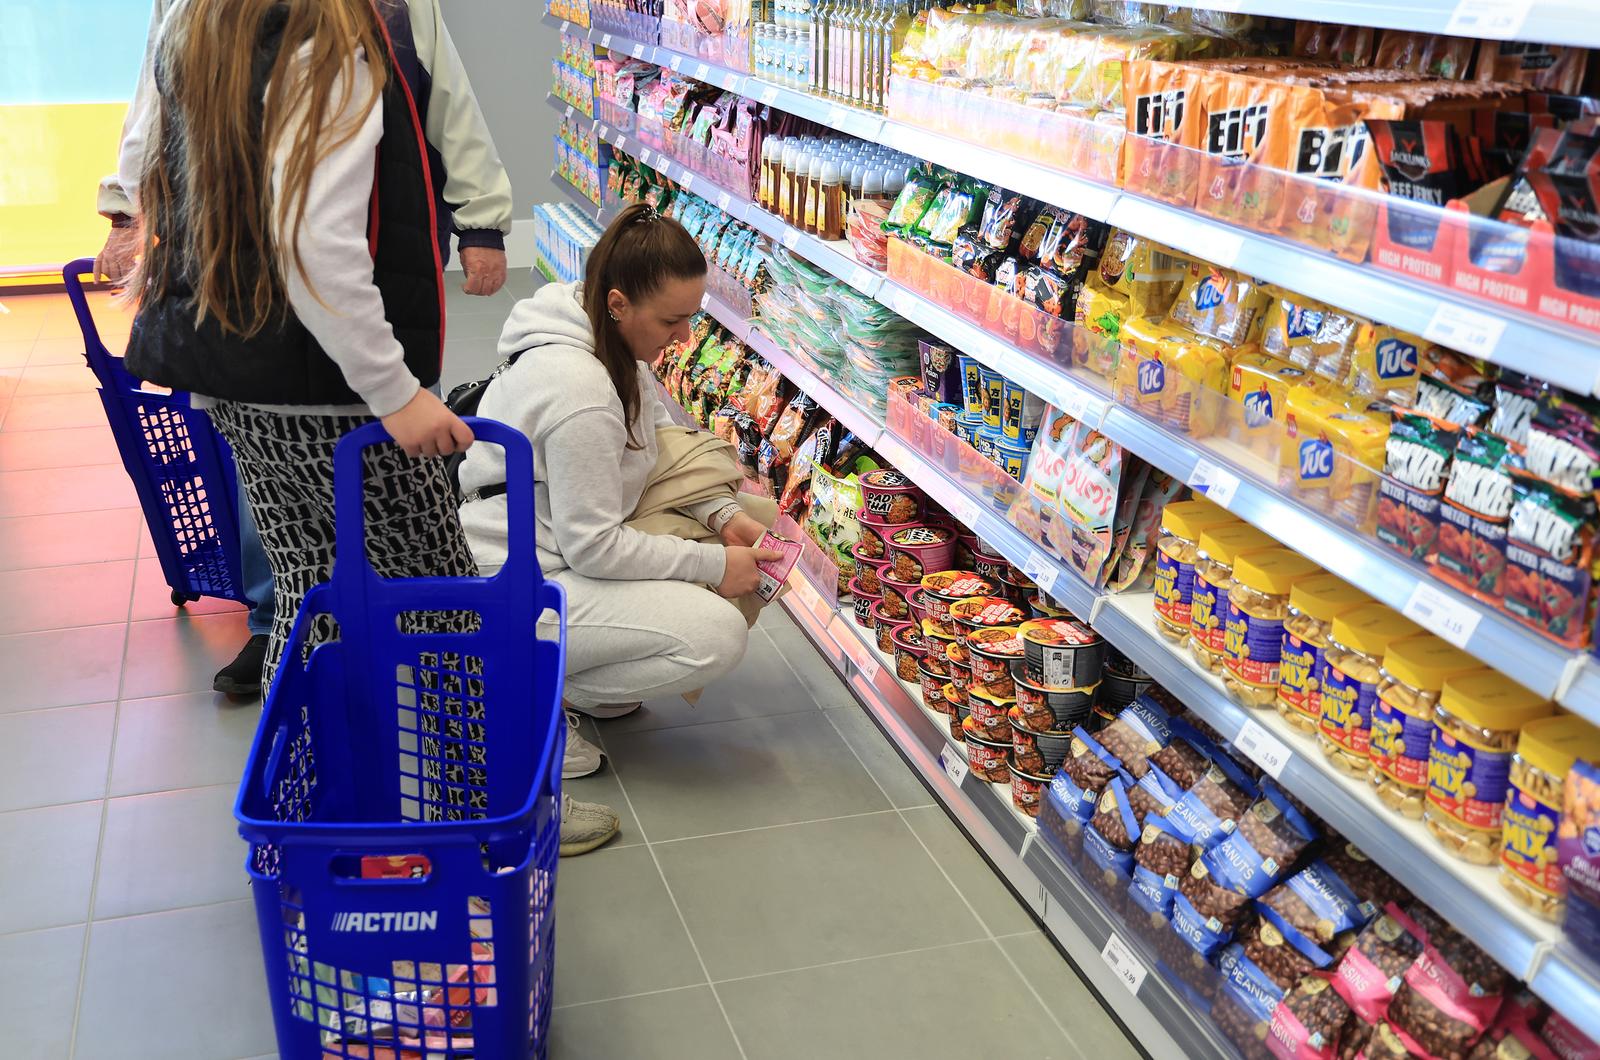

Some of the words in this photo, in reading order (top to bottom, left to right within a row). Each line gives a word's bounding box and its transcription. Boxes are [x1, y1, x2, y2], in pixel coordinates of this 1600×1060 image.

[1379, 248, 1400, 268] HIGH
[1402, 254, 1442, 280] PROTEIN
[1455, 271, 1480, 291] HIGH
[1481, 278, 1527, 304] PROTEIN
[1538, 294, 1568, 317] HIGH
[1379, 342, 1414, 376] TUC
[1139, 363, 1161, 391] TUC
[1245, 395, 1271, 422] TUC
[1301, 444, 1331, 475] TUC
[866, 500, 892, 513] THAI
[1279, 660, 1311, 694] MIX
[1129, 701, 1173, 738] PEANUTS
[1321, 694, 1353, 729] MIX
[1051, 778, 1081, 813] PEANUTS
[1427, 760, 1466, 799] MIX
[1174, 801, 1213, 839] EANUTS
[1502, 819, 1549, 864] MIX
[1222, 840, 1255, 881] ANUTS
[345, 911, 438, 932] ACTION
[1232, 968, 1277, 1012] PEANUTS
[1340, 958, 1369, 993] AISINS
[1270, 1017, 1297, 1053] AISINS
